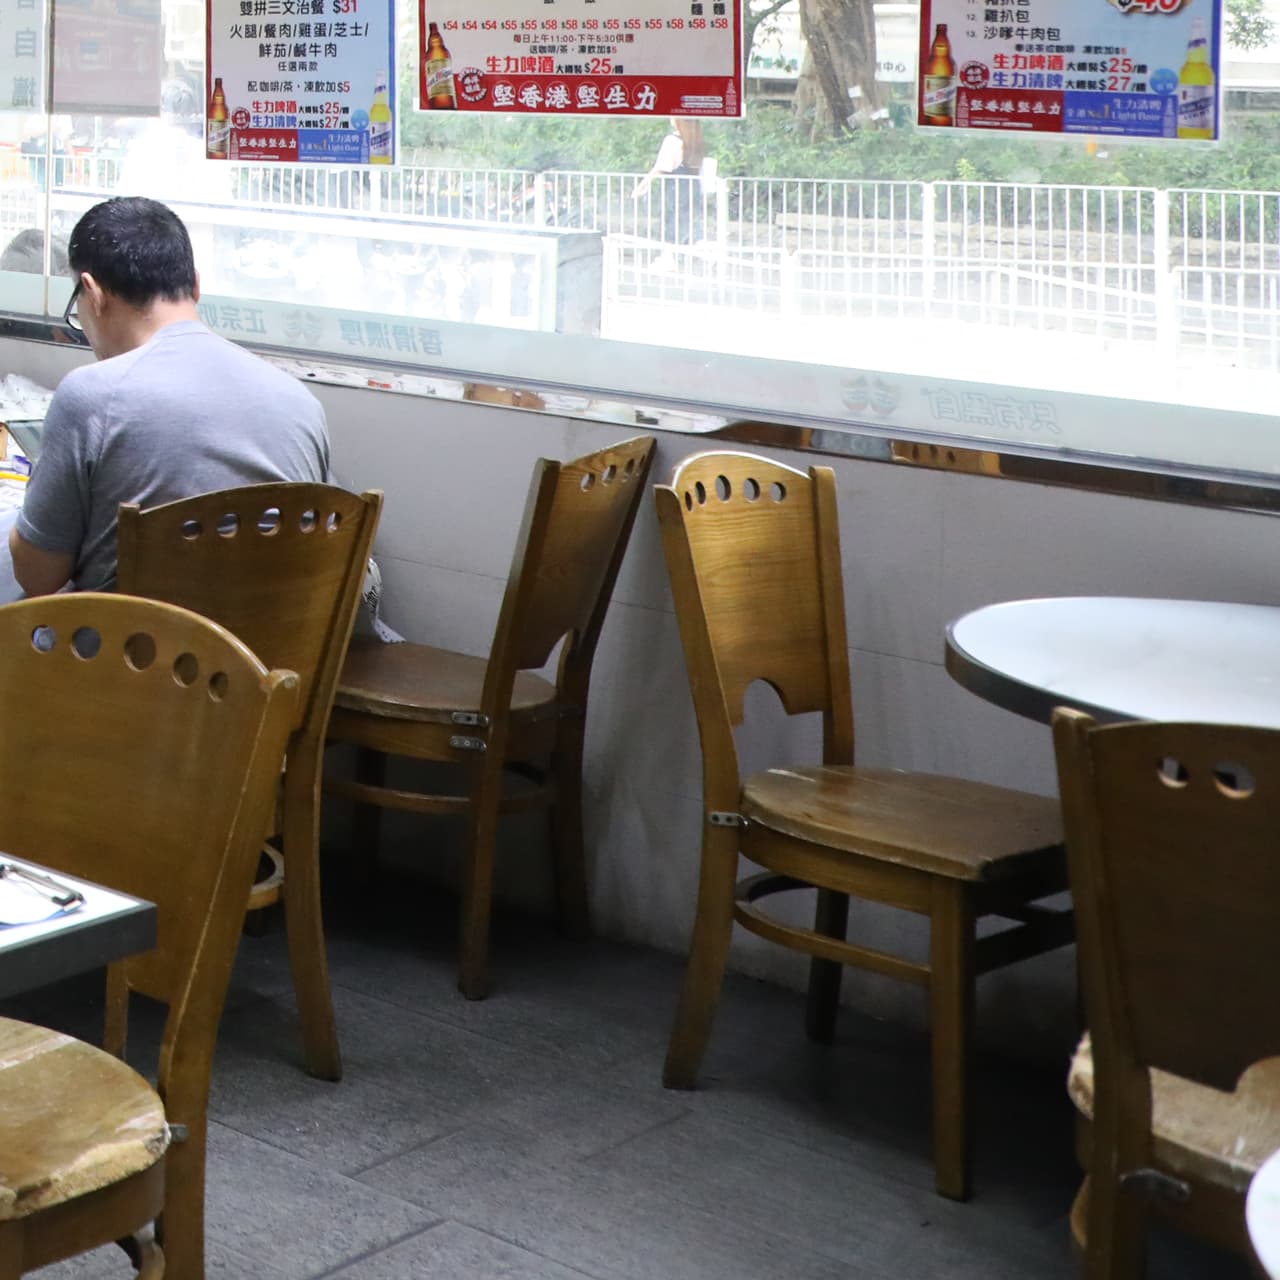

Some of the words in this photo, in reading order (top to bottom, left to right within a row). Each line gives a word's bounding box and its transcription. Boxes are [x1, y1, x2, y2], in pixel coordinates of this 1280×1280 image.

[240, 0, 324, 16] 雙拼三文治餐
[278, 62, 318, 72] 任選兩款
[487, 56, 554, 73] 生力啤酒
[994, 54, 1064, 71] 生力啤酒
[992, 72, 1063, 88] 生力清啤
[493, 84, 571, 108] 堅香港
[576, 84, 657, 111] 堅生力
[252, 101, 297, 114] 生力啤酒
[252, 115, 297, 128] 生力清啤
